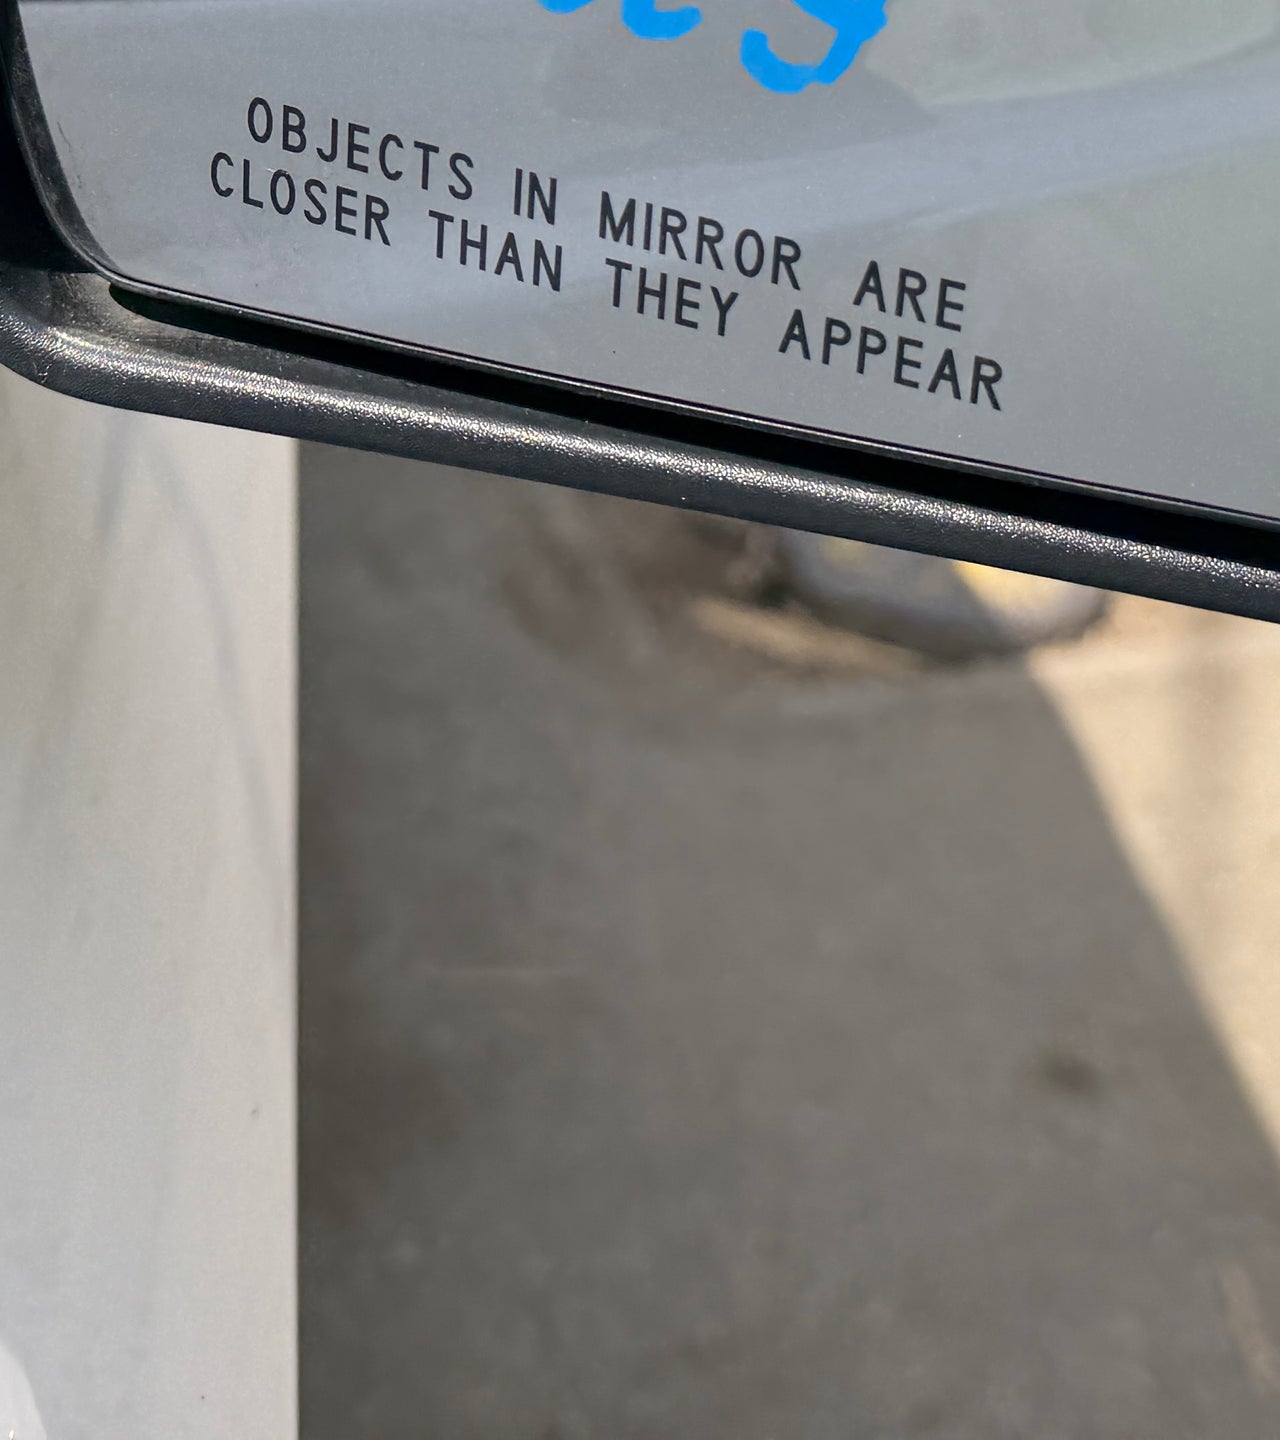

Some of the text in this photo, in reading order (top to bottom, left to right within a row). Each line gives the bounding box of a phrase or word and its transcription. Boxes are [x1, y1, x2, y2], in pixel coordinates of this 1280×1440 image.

[209, 150, 1005, 413] CLOSER THAN THEY APPEAR
[246, 95, 968, 334] OBJECTS IN MIRROR ARE
